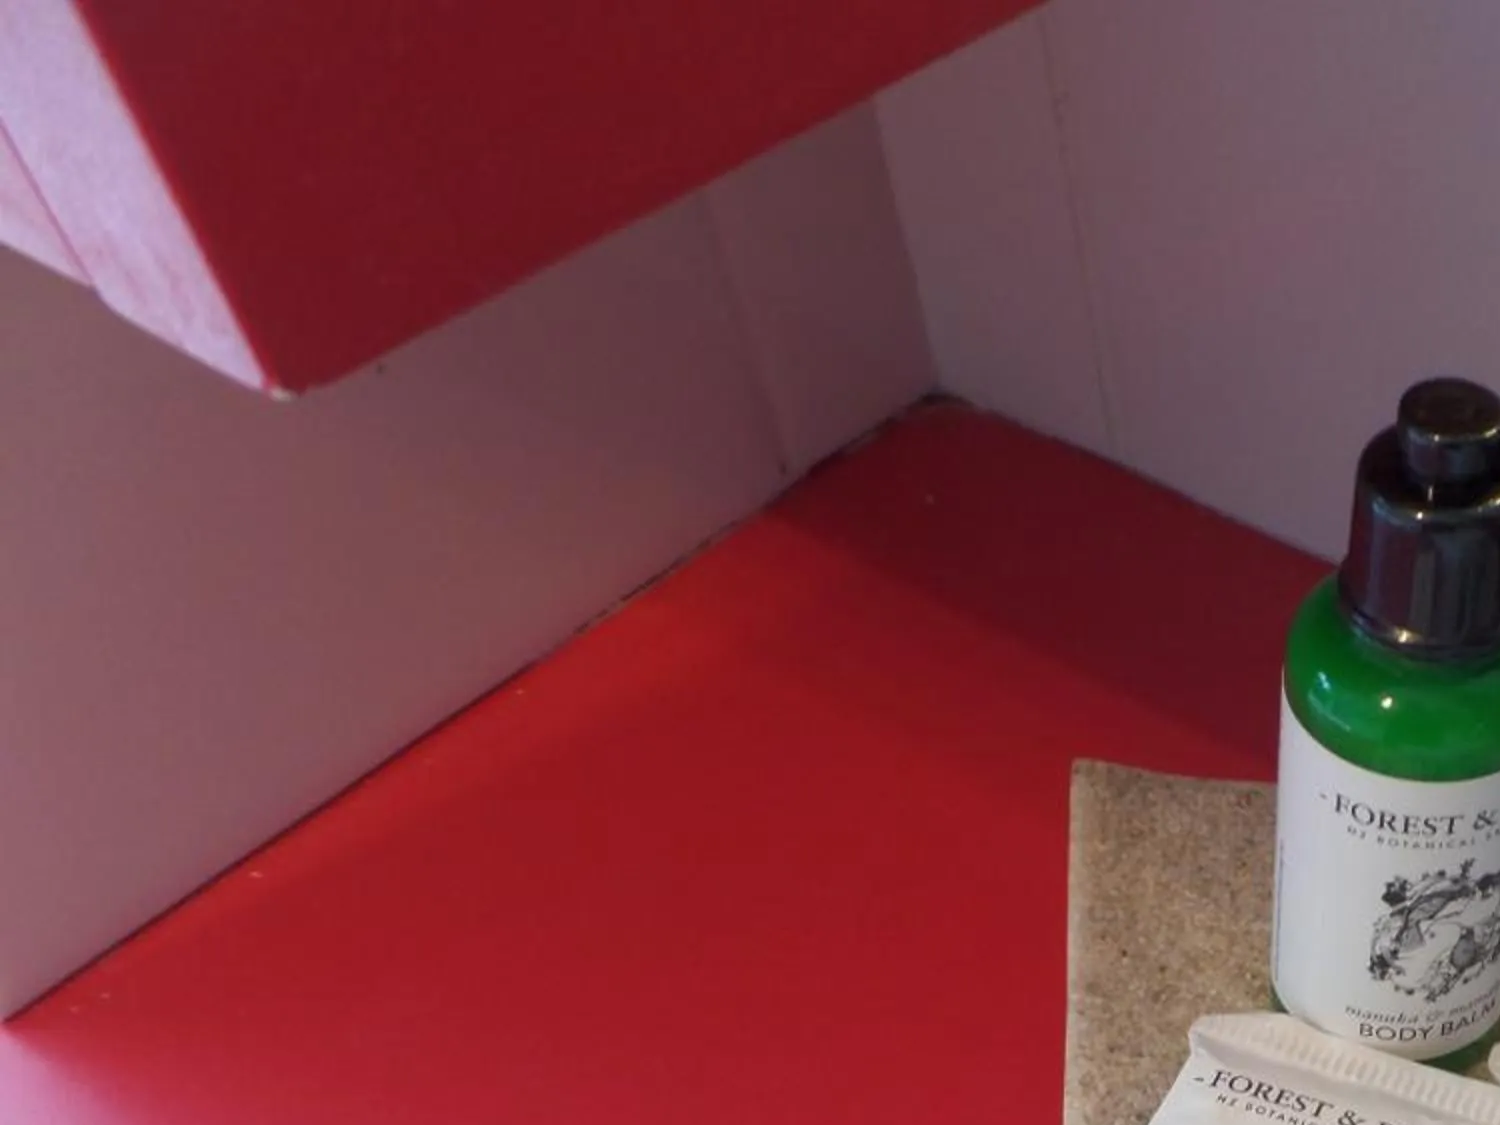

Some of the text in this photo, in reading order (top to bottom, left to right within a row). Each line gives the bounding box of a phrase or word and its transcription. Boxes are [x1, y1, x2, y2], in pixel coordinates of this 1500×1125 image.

[1333, 792, 1465, 836] FOREST
[1473, 809, 1498, 831] &
[1358, 1021, 1435, 1043] BODY
[1209, 1069, 1335, 1119] FOREST
